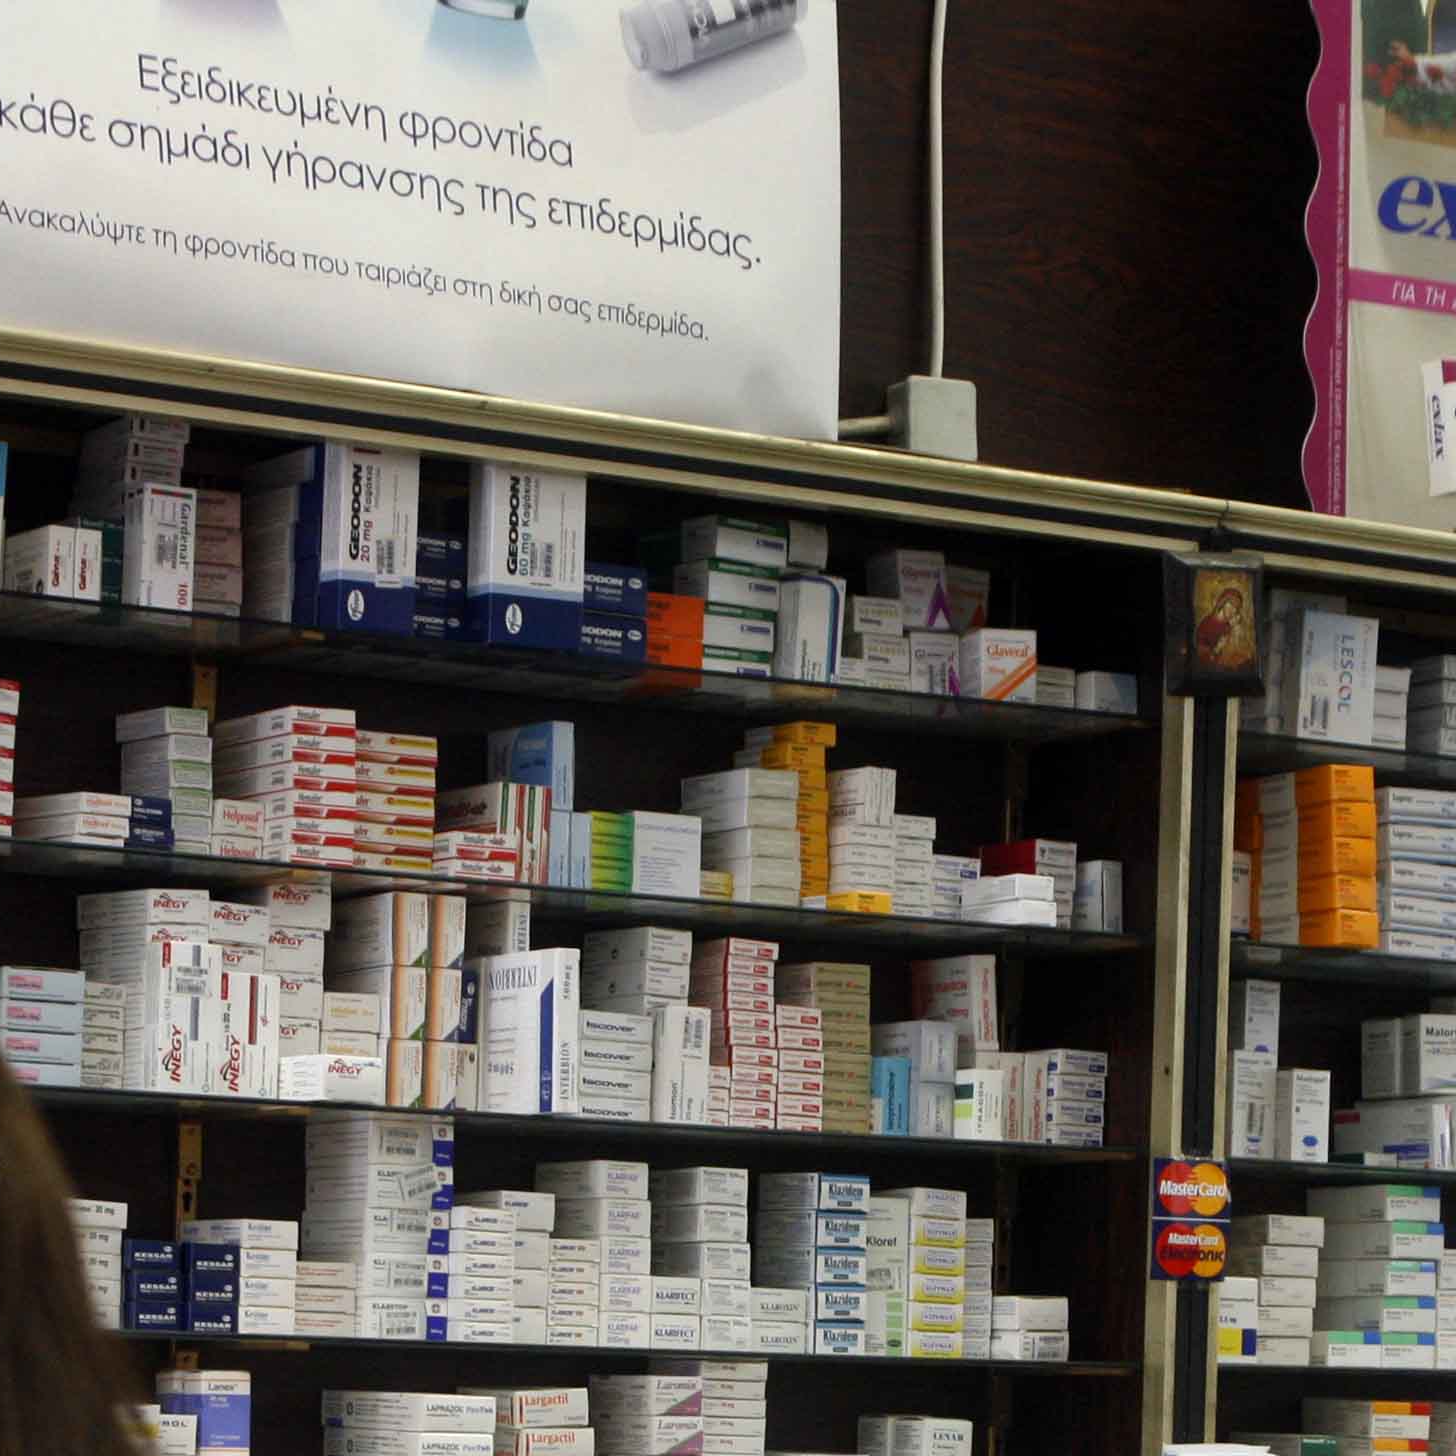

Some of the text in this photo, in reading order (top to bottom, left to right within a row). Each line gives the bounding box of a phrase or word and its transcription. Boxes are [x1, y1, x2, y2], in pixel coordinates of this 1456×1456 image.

[138, 54, 574, 168] Εξειδικευμένη φροντίδα
[109, 118, 252, 169] σημάδι
[263, 141, 465, 216] γήρανσης
[476, 181, 537, 229] της
[548, 197, 762, 270] επιδερμίδας.
[152, 227, 178, 255] τη
[185, 234, 296, 270] φροντίδα
[302, 252, 349, 277] που
[356, 260, 447, 297] ταιριάζει
[454, 278, 494, 305] στη
[499, 281, 542, 312] δική
[547, 294, 592, 323] σας
[597, 302, 709, 342] επιδερμίδα.
[1392, 280, 1416, 303] ΓΙΑ
[1425, 285, 1446, 308] ΤΗ
[348, 463, 362, 560] GEODON
[506, 475, 521, 576] GEODON
[1336, 633, 1356, 713] LESCOL
[153, 899, 189, 909] INEGY
[272, 890, 311, 902] INEGY
[213, 910, 251, 922] INEGY
[269, 935, 304, 947] INEGY
[488, 964, 539, 992] INTERBION
[169, 1024, 184, 1083] INEGY
[228, 1034, 241, 1093] INEGY
[327, 1063, 363, 1075] INEGY
[1160, 1179, 1231, 1198] MasterCard
[426, 1403, 464, 1413] LAPRAZOL
[525, 1393, 569, 1408] Largactil
[422, 1442, 460, 1451] LAPRAZOL
[532, 1433, 576, 1445] Largactil
